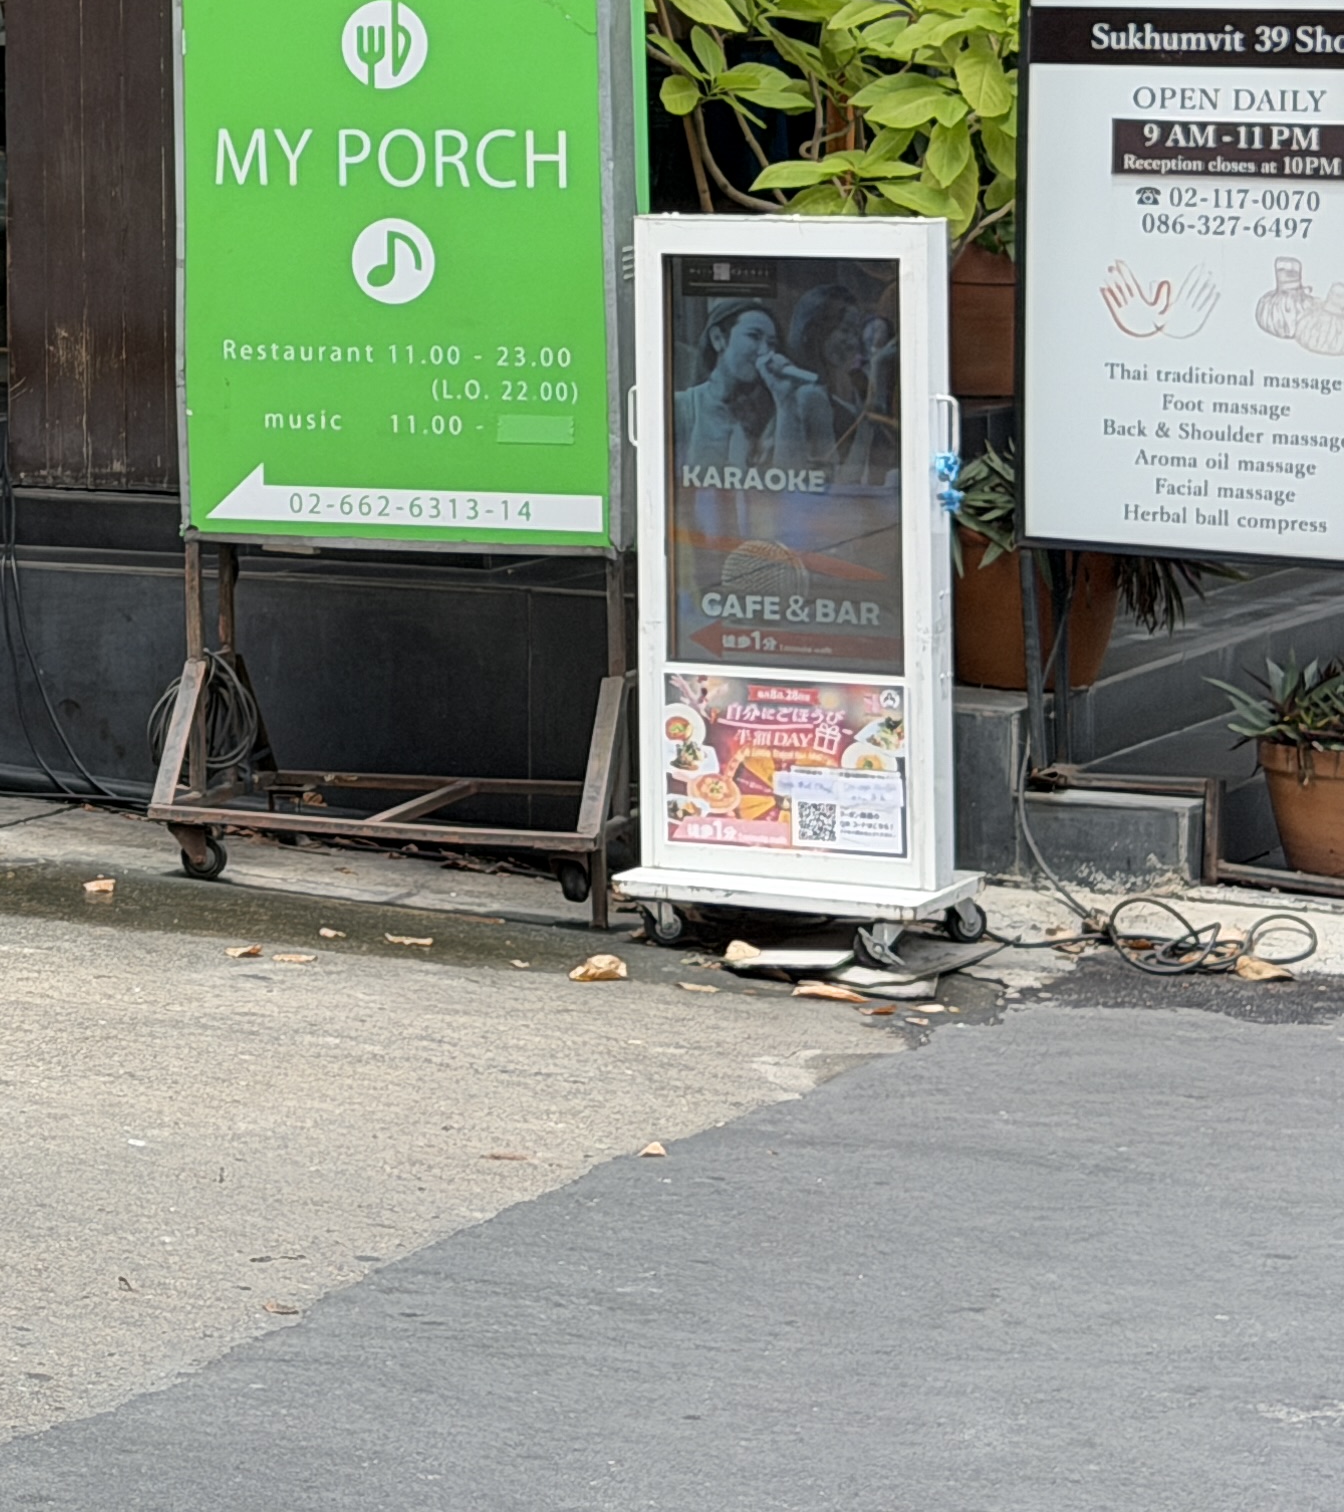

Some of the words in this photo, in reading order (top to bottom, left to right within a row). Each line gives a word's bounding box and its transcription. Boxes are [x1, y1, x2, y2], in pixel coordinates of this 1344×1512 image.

[1091, 22, 1245, 53] Sukhumvit
[1254, 26, 1290, 53] 39
[1133, 86, 1221, 110] OPEN
[1233, 89, 1328, 112] DAILY
[215, 128, 313, 186] MY
[338, 128, 568, 189] PORCH
[1123, 153, 1204, 174] Reception
[1208, 155, 1255, 175] closes
[1261, 159, 1278, 174] at
[1169, 187, 1321, 212] 02-117-0070
[1142, 213, 1313, 239] 086-327-6497
[223, 339, 374, 364] Restaurant
[389, 345, 461, 366] 11.00
[497, 347, 572, 368] 23.00
[431, 378, 489, 403] (L.O.
[500, 380, 579, 405] 22.00)
[1104, 362, 1148, 382] Thai
[1156, 366, 1254, 387] traditional
[1263, 375, 1343, 396] massage
[1162, 394, 1204, 412] Foot
[1212, 402, 1291, 421] massage
[264, 408, 343, 431] music
[389, 414, 463, 436] 11.00
[1103, 419, 1147, 438] Back
[1155, 422, 1171, 439] &
[1178, 422, 1264, 444] Shoulder
[1134, 449, 1197, 469] Aroma
[1205, 452, 1230, 470] oil
[1237, 459, 1317, 479] massage
[682, 464, 827, 494] KARAOKE
[1155, 478, 1209, 498] Facial
[1217, 486, 1296, 506] massage
[289, 493, 533, 523] 02-662-6313-14
[1123, 504, 1187, 525] Herbal
[1195, 508, 1229, 527] ball
[1237, 515, 1328, 535] compress
